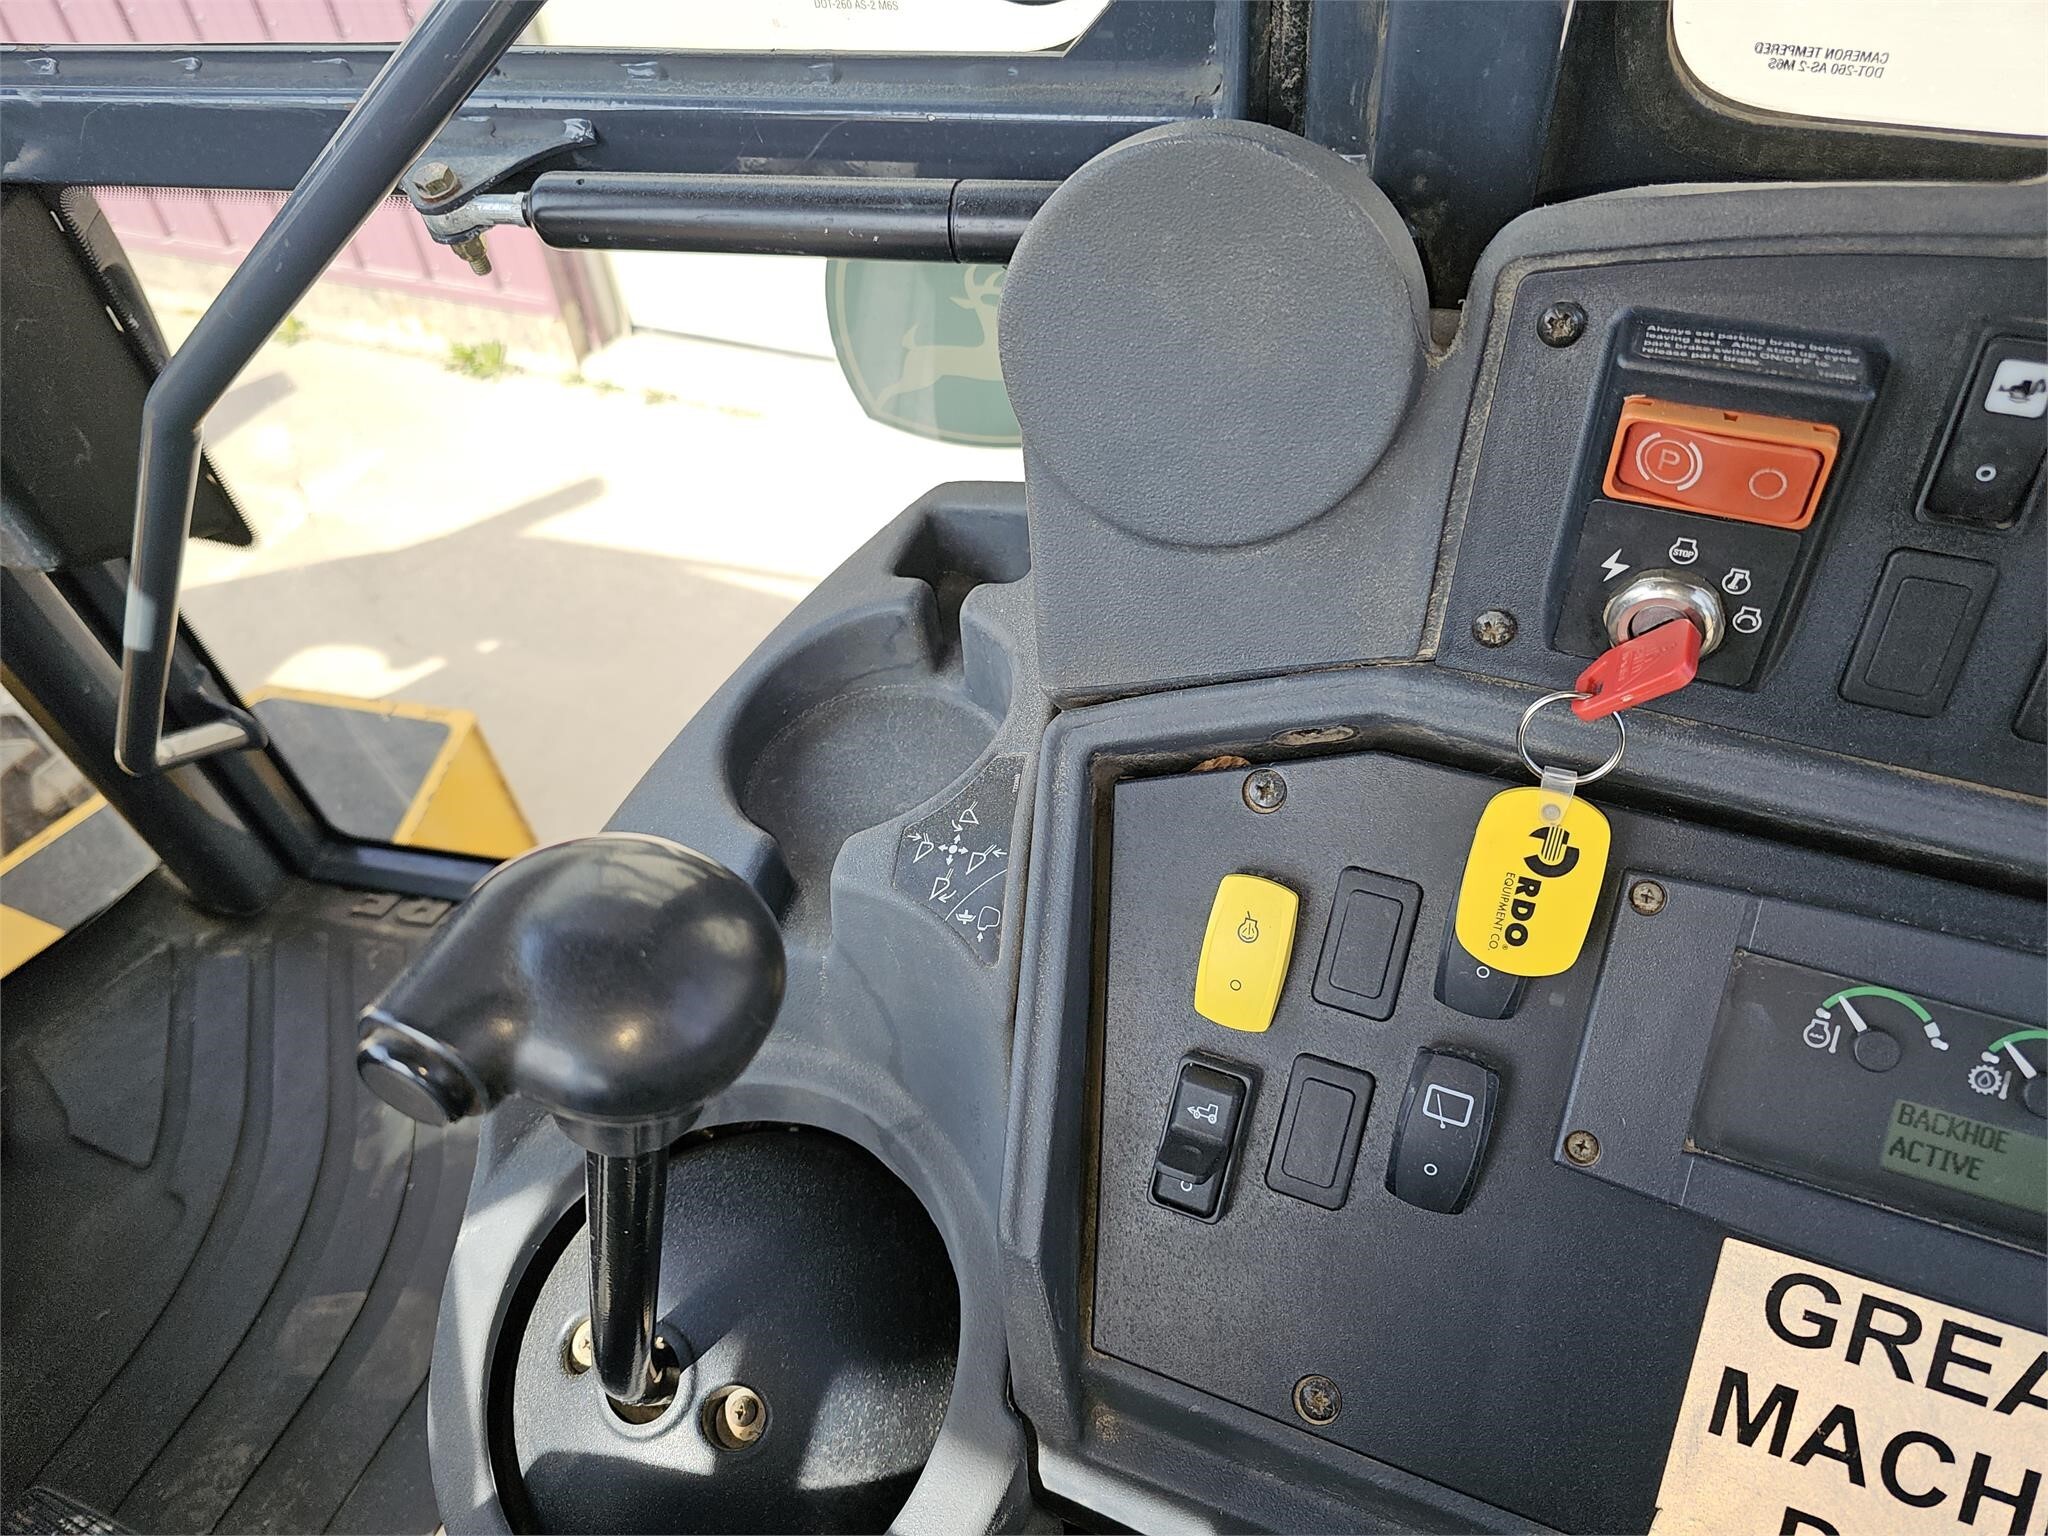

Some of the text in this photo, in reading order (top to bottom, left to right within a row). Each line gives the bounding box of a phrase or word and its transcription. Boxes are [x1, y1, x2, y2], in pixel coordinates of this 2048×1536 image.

[854, 0, 876, 10] AS-2
[1642, 347, 1688, 357] release
[1691, 352, 1719, 360] park
[1643, 339, 1671, 348] park
[1674, 343, 1711, 352] brake
[1714, 347, 1757, 357] switch
[1645, 332, 1691, 344] leaving
[1731, 341, 1763, 350] After
[1766, 346, 1796, 355] start
[1824, 353, 1859, 364] cycle
[1646, 325, 1852, 355] Always set parking brake before
[1657, 448, 1680, 471] P
[1672, 549, 1694, 559] STOP
[1487, 871, 1516, 950] EQUIPMENT CO.
[1504, 875, 1542, 946] RDO
[1897, 1102, 2009, 1154] BACKHOE
[1888, 1136, 1983, 1181] ACTIVE
